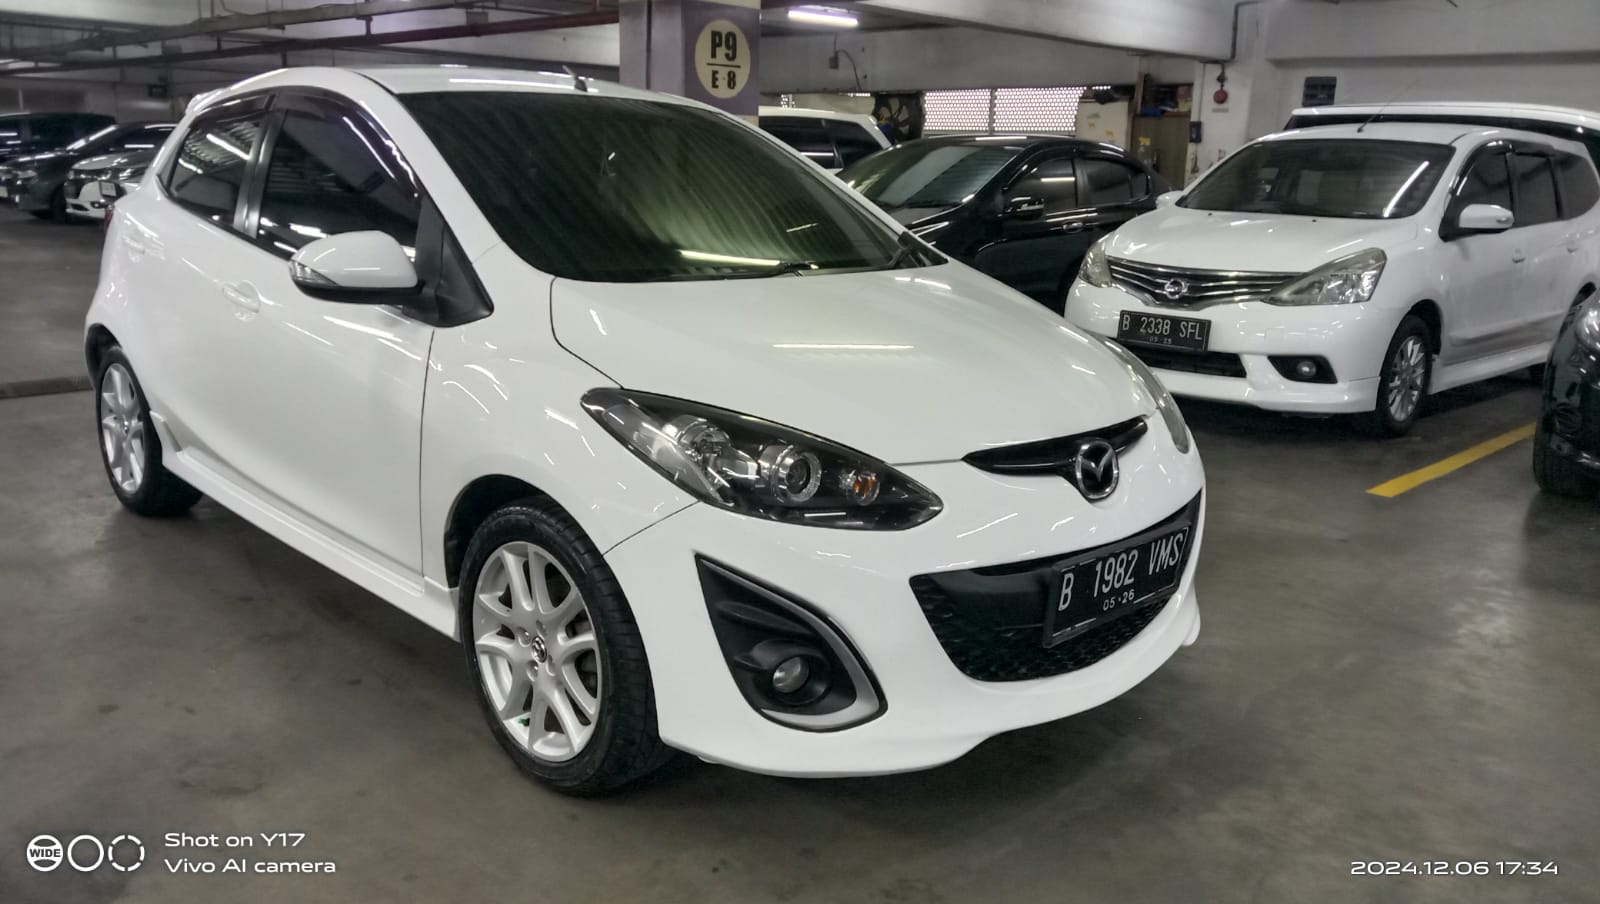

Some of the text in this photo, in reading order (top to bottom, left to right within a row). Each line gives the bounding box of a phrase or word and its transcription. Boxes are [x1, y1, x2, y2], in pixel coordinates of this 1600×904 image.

[711, 30, 737, 61] P9
[1122, 315, 1202, 340] B 2338 SFL
[1058, 533, 1183, 611] B 1982 VMS
